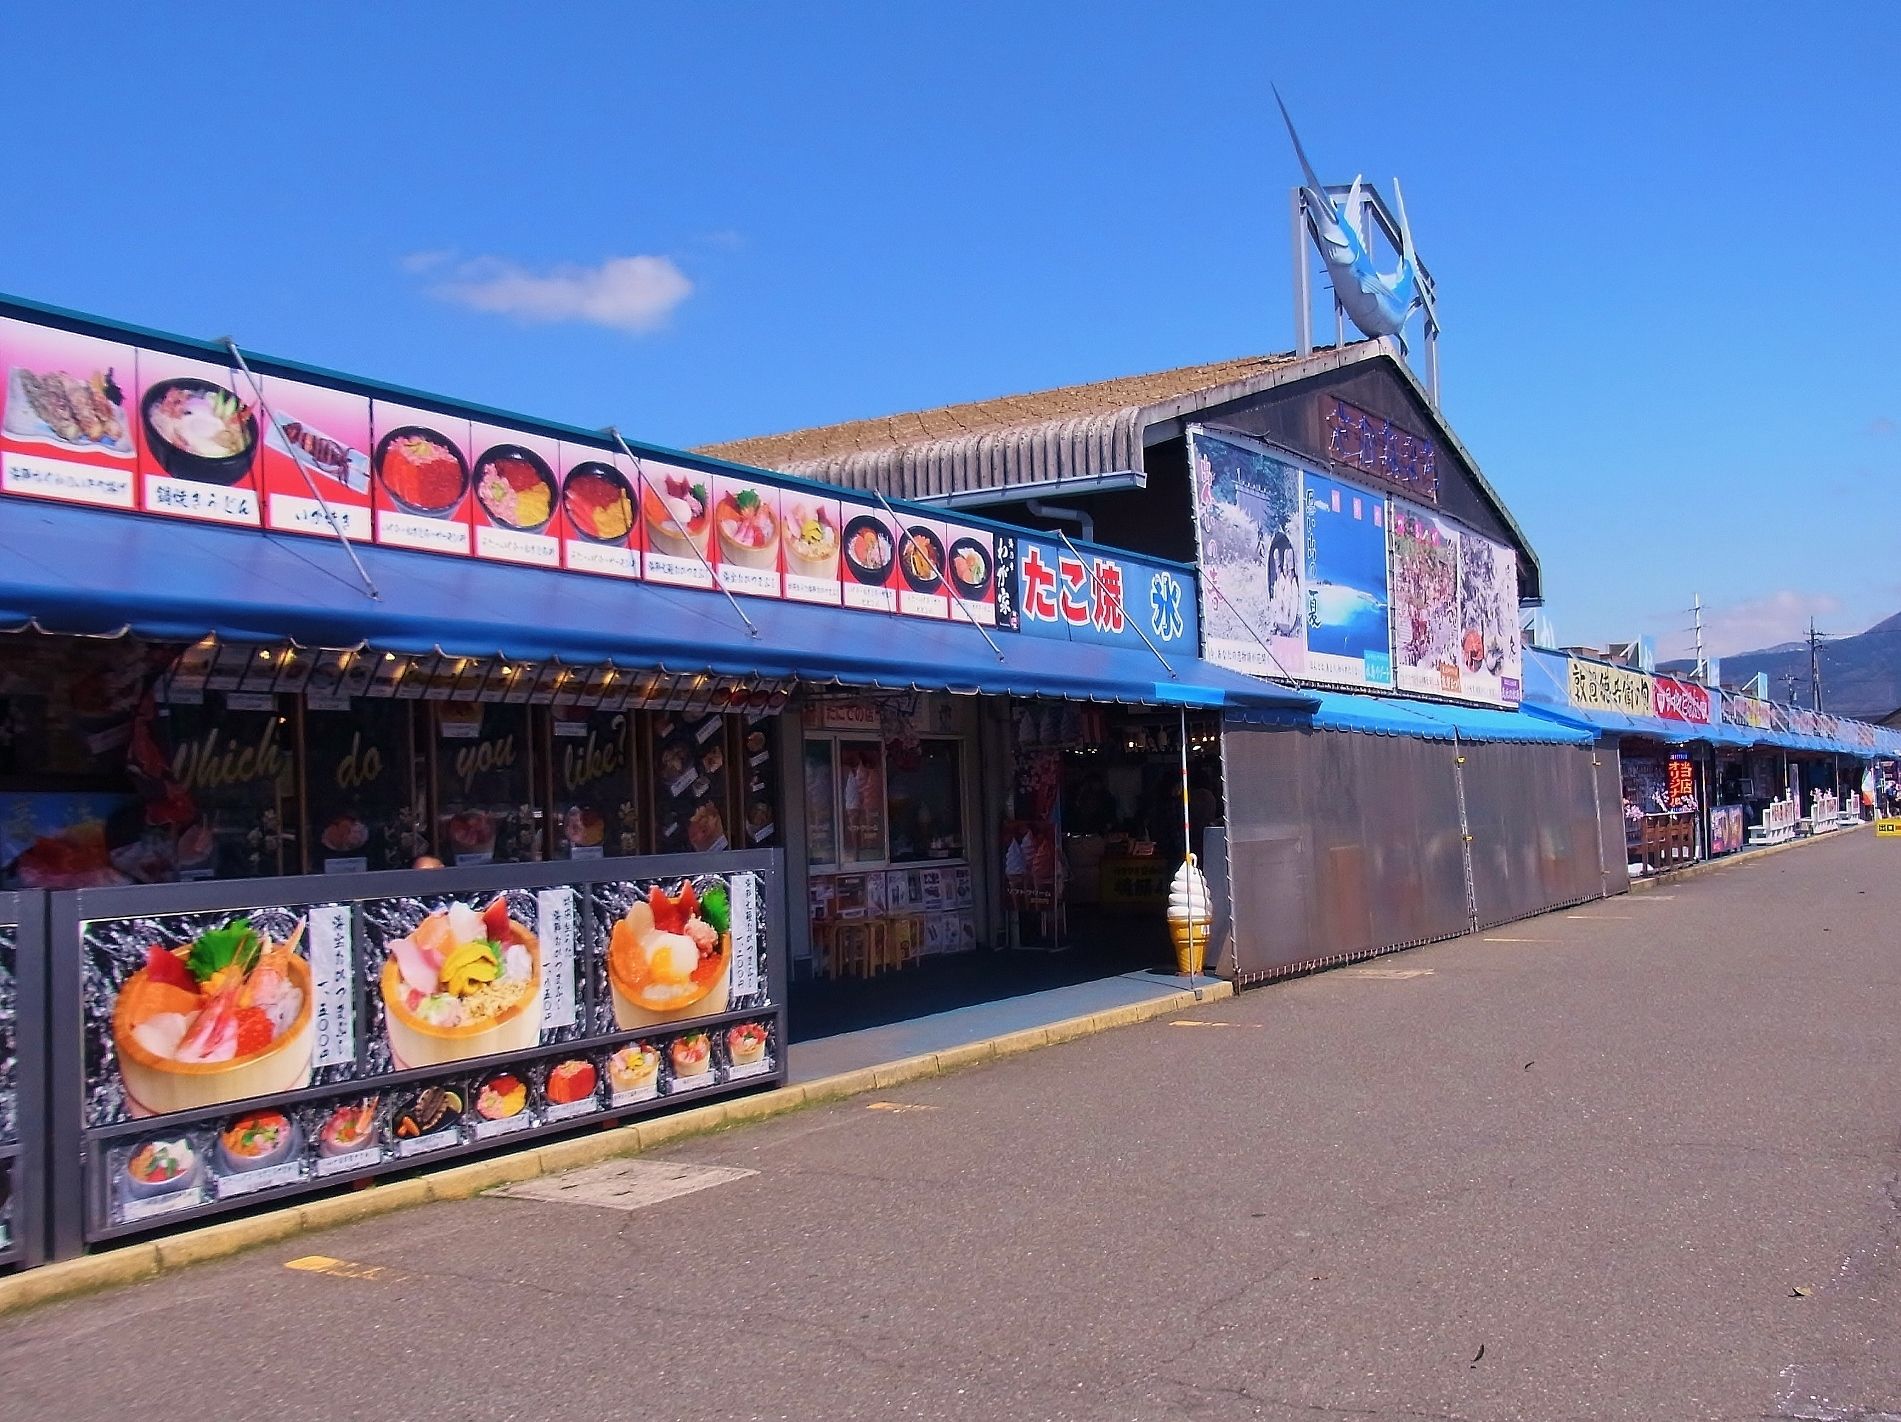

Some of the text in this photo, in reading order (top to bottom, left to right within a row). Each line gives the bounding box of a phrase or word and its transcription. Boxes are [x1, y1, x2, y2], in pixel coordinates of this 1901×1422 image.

[156, 486, 249, 515] 鍋焼きうどん
[997, 537, 1011, 615] わが家
[1021, 545, 1125, 633] たこ焼
[1151, 571, 1183, 641] 氷
[172, 714, 627, 794] Which do you like?
[1669, 761, 1681, 806] オリジナル
[1680, 761, 1692, 793] 当店
